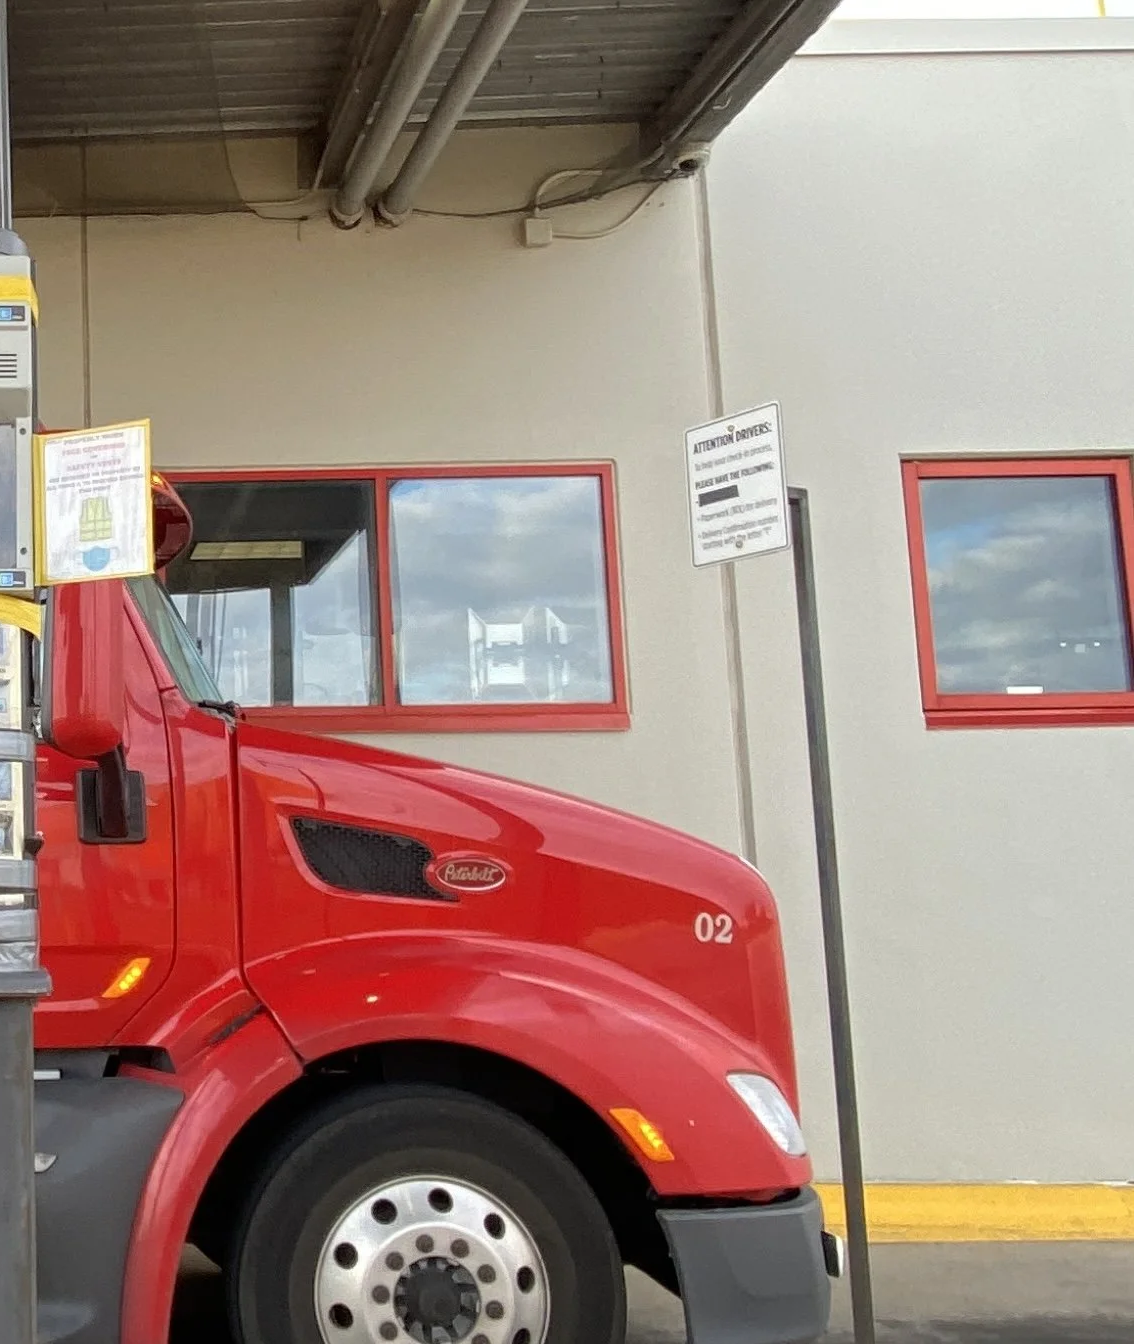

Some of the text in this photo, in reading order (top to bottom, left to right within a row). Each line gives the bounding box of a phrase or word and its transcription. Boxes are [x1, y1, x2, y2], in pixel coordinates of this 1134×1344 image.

[693, 421, 772, 455] ATTENTION DRIVERS:
[445, 863, 499, 882] Peterbilt
[694, 912, 733, 944] 02
